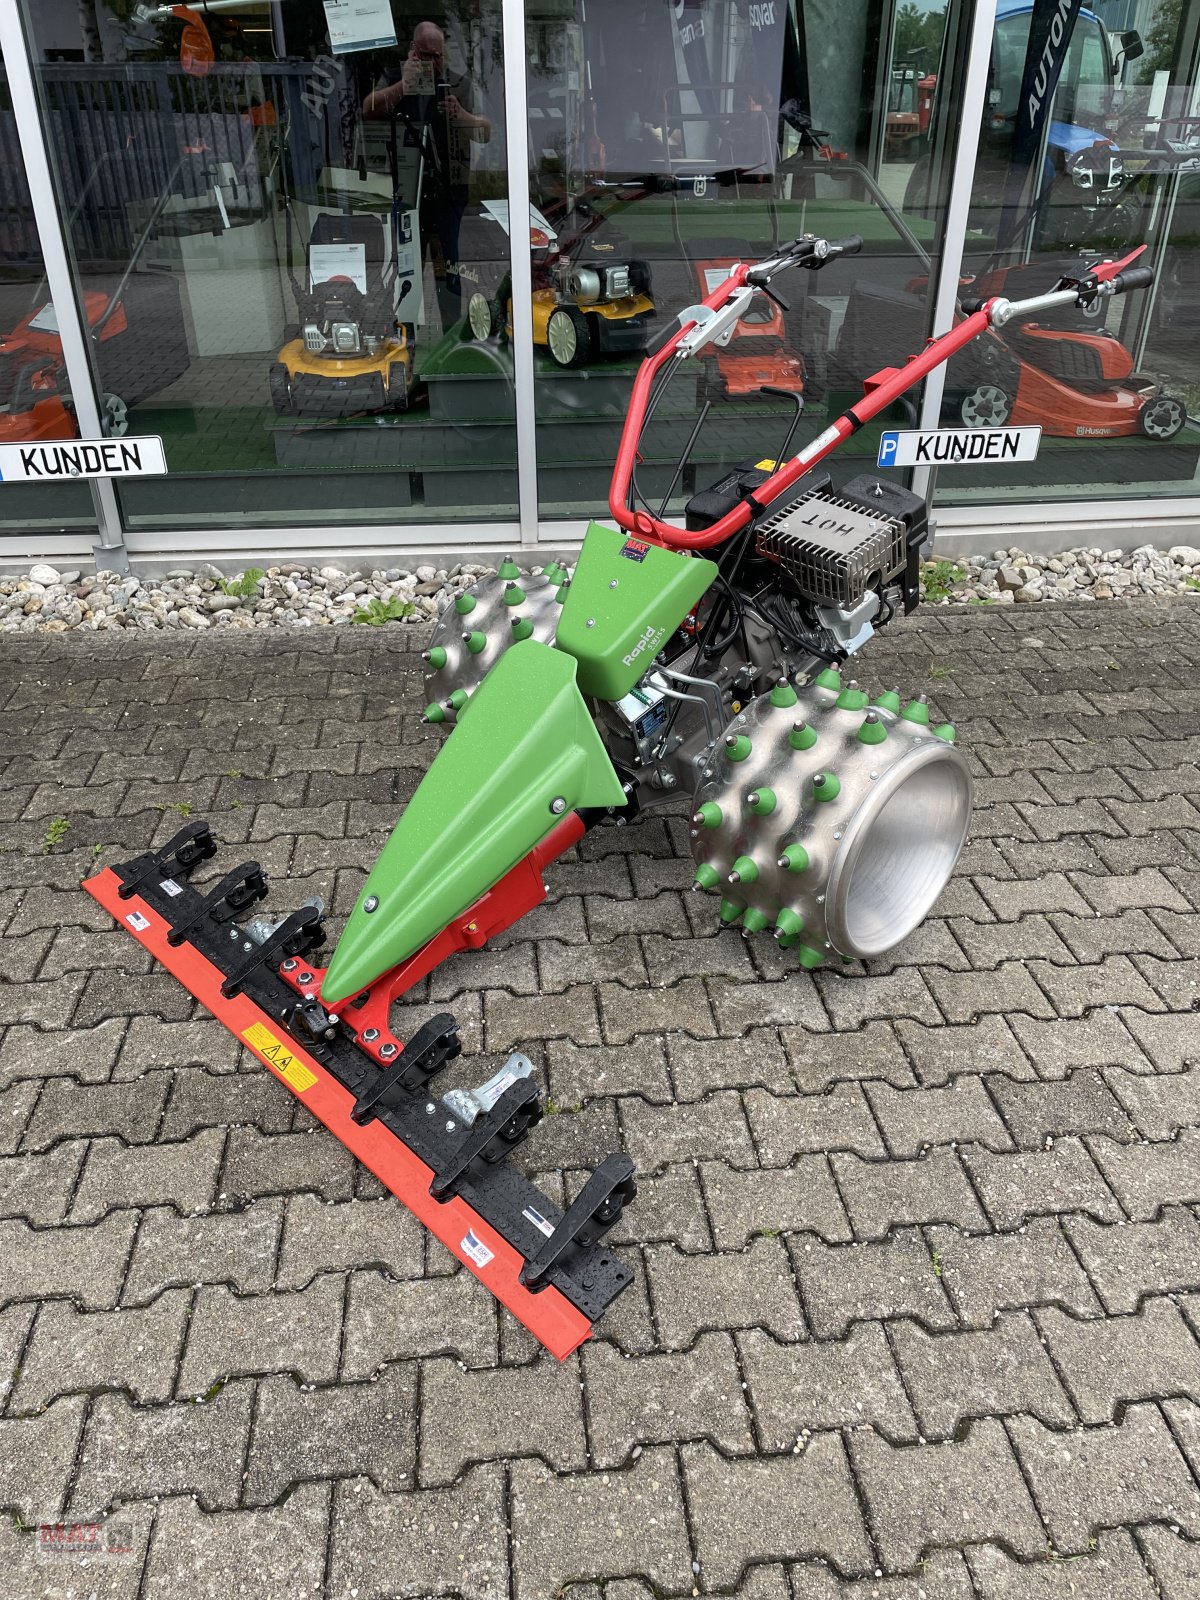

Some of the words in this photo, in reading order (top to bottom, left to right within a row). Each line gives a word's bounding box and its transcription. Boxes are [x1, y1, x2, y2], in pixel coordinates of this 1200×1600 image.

[20, 443, 142, 476] KUNDEN
[881, 439, 897, 460] P
[915, 432, 1021, 461] KUNDEN
[801, 514, 855, 537] HOT
[626, 539, 649, 553] MAT
[622, 625, 656, 667] Rapid
[647, 627, 666, 650] SWISS
